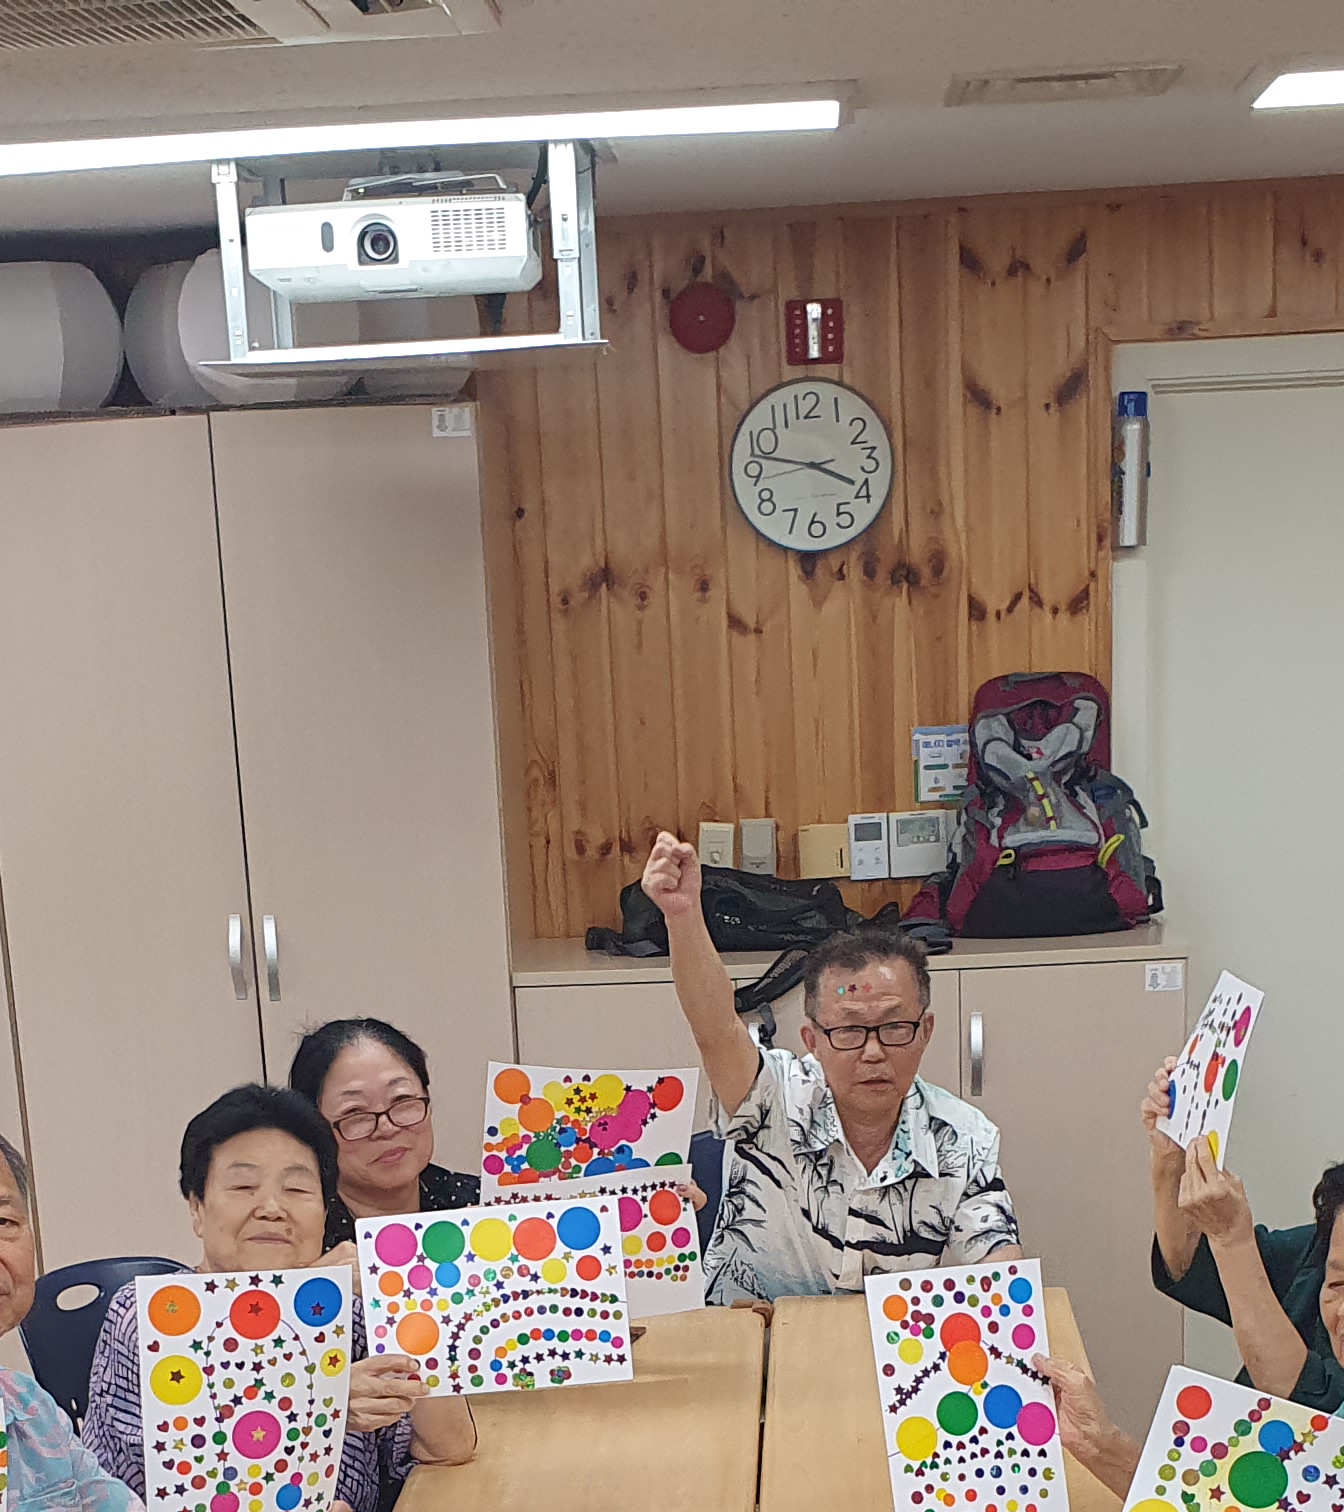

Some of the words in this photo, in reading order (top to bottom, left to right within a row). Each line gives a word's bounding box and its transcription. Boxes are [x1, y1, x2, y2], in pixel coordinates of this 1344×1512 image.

[771, 404, 789, 430] 11
[793, 391, 821, 421] 12
[833, 397, 840, 423] 1
[749, 427, 778, 456] 10
[848, 417, 868, 445] 2
[744, 460, 763, 487] 9
[860, 446, 880, 474] 3
[757, 488, 777, 516] 8
[854, 477, 872, 503] 4
[782, 507, 799, 535] 7
[807, 511, 827, 538] 6
[835, 502, 855, 529] 5
